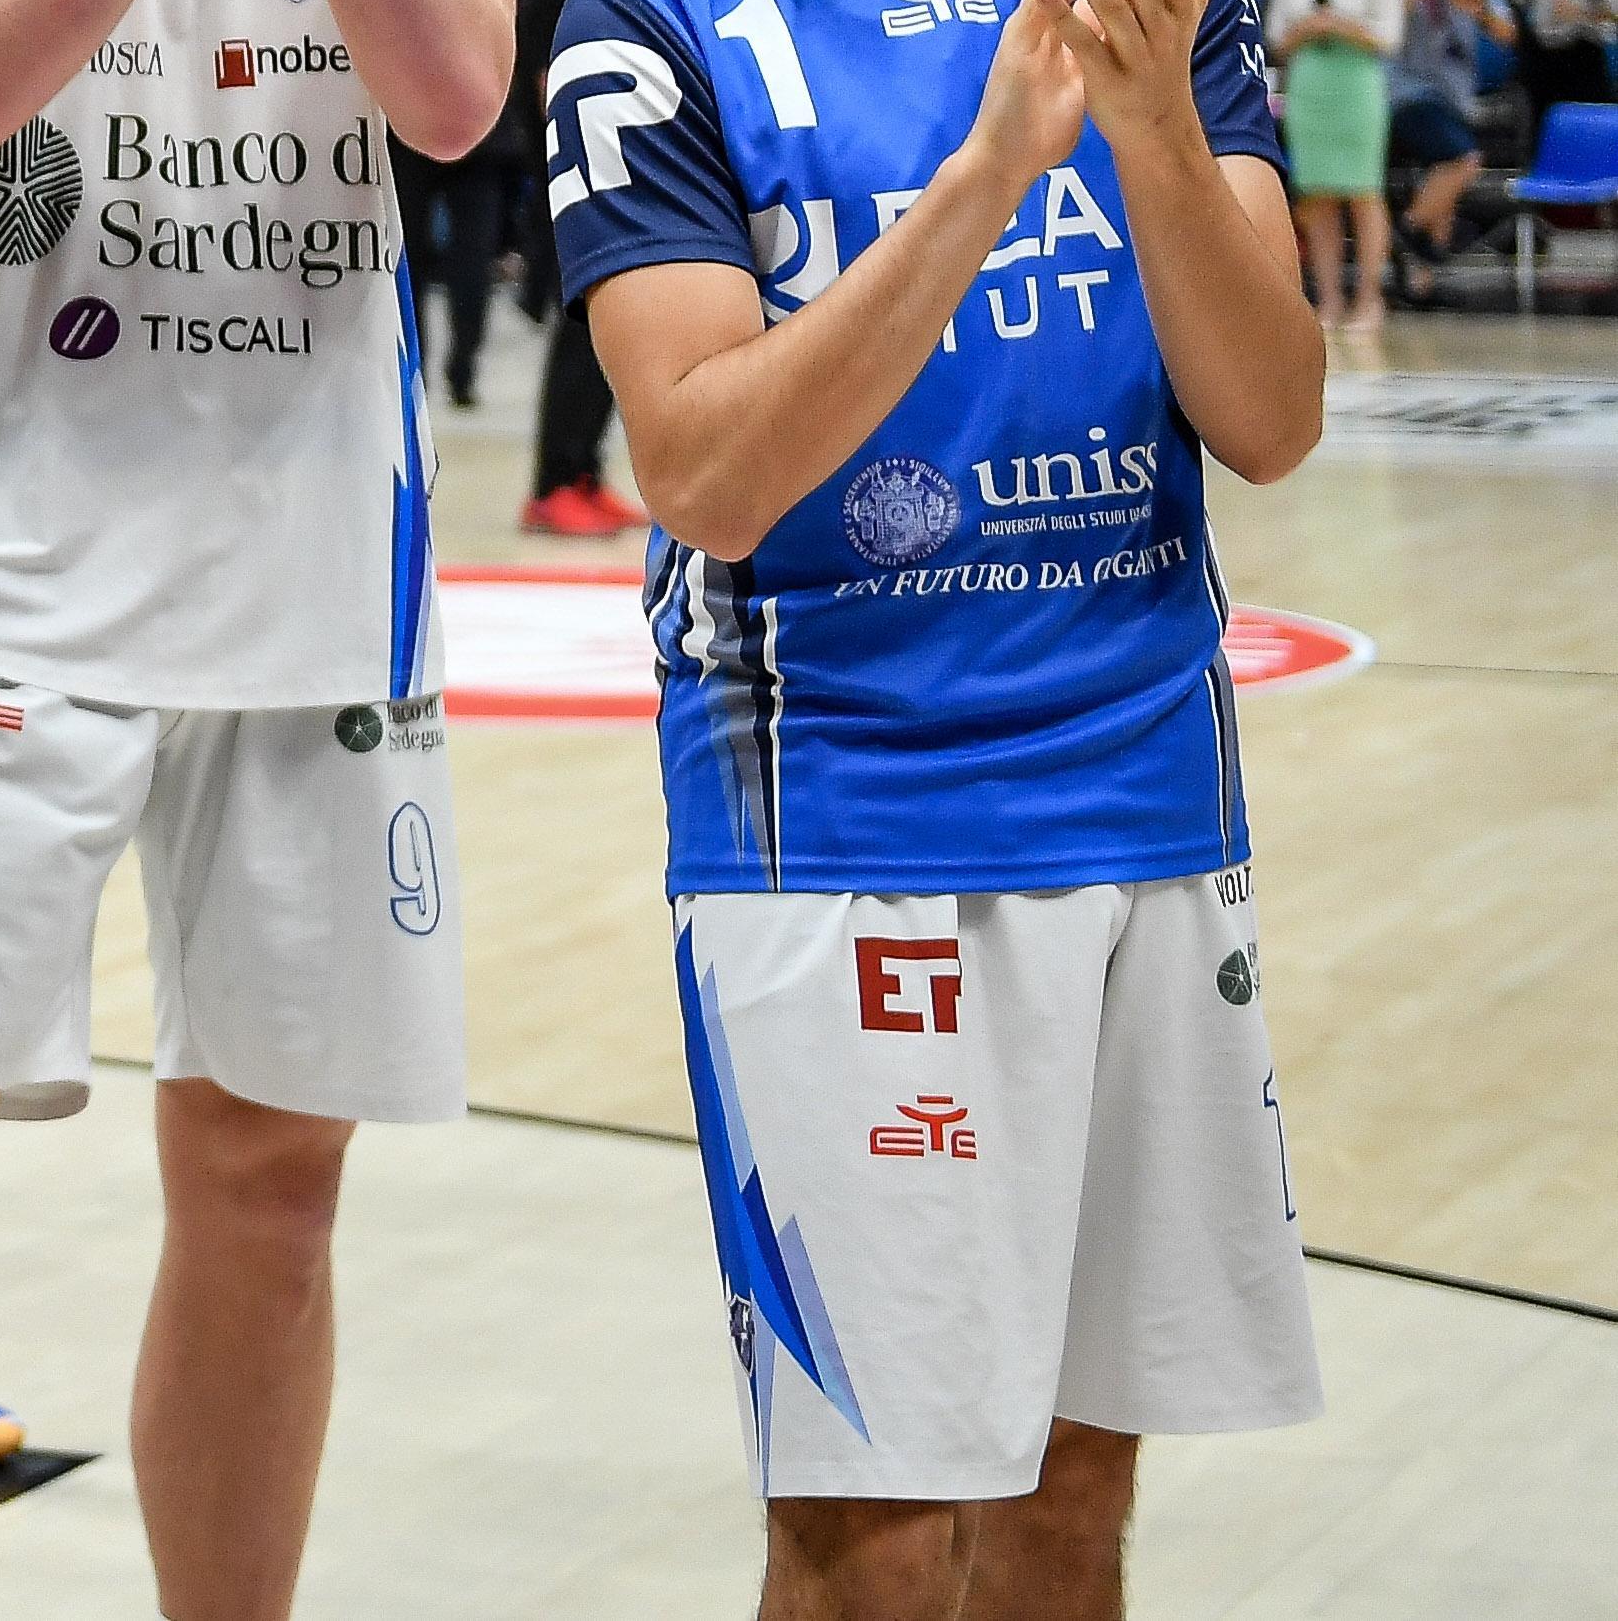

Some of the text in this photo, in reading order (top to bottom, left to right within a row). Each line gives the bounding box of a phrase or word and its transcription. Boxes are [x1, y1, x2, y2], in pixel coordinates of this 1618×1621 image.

[103, 112, 310, 189] Banco
[140, 313, 312, 355] TISCALI
[980, 515, 1048, 537] UNIVERSITÀ
[1050, 511, 1087, 530] DEGLI
[1089, 509, 1128, 527] STUDI
[890, 560, 1029, 596] FUTURO
[1036, 561, 1085, 590] DA
[387, 800, 442, 936] 9
